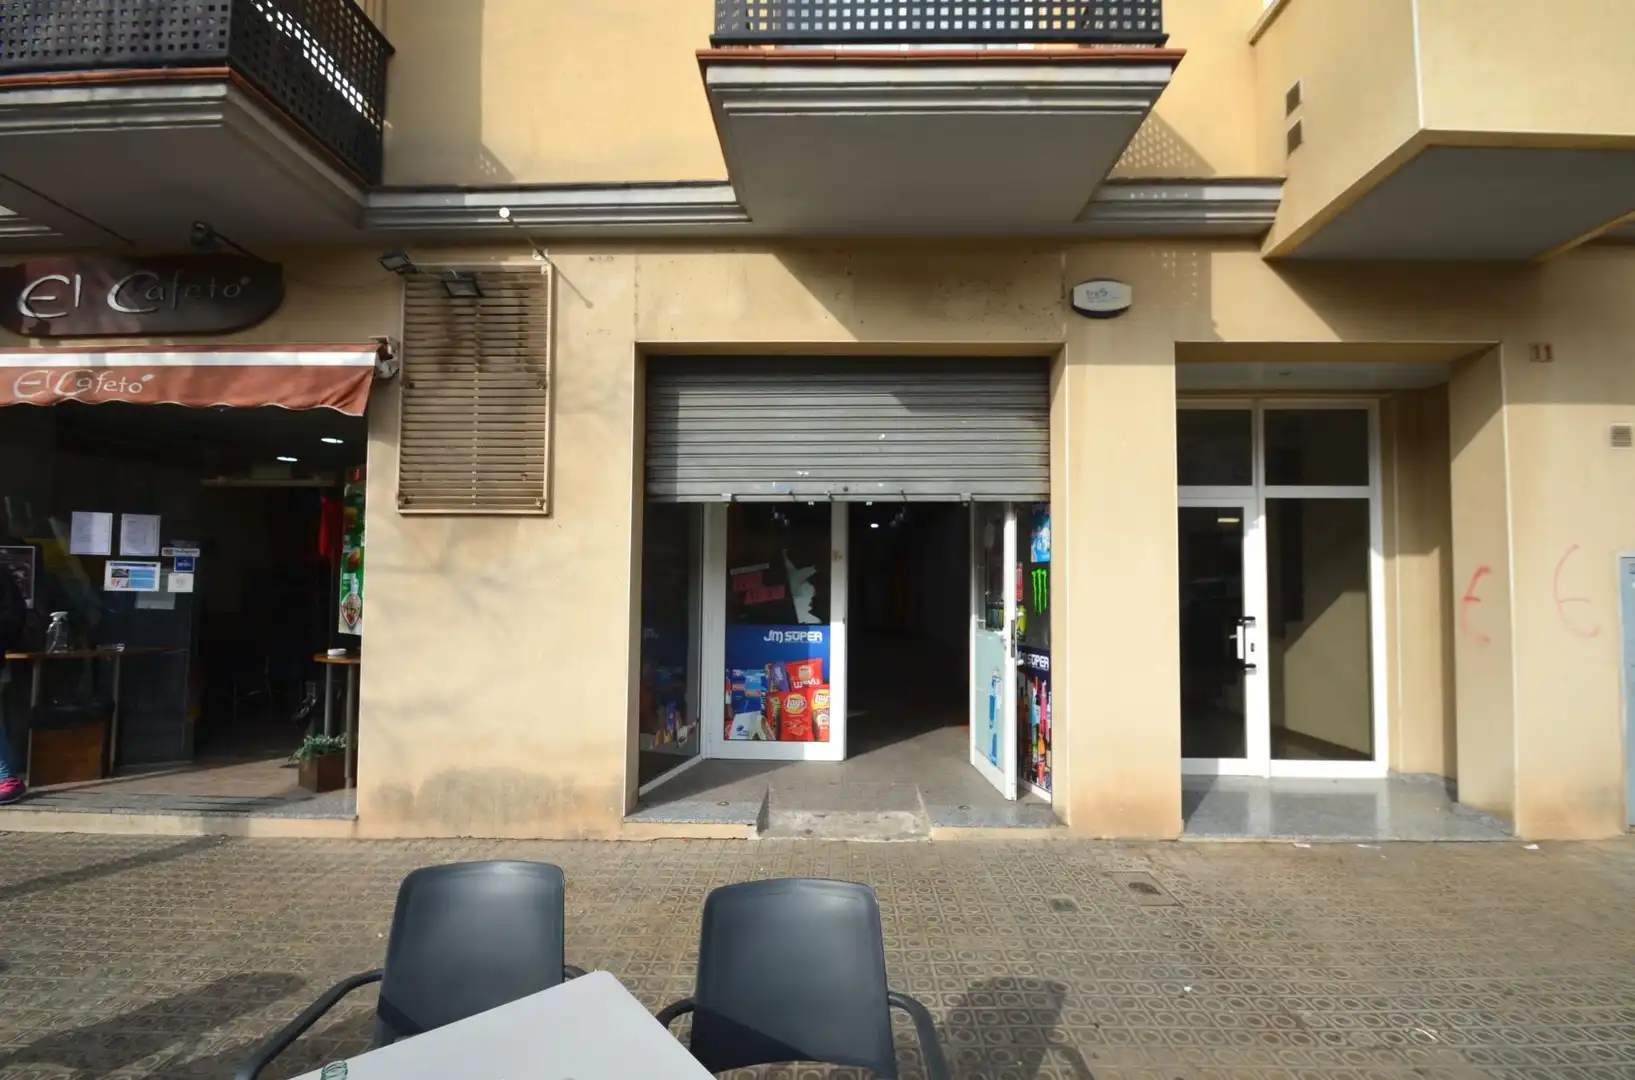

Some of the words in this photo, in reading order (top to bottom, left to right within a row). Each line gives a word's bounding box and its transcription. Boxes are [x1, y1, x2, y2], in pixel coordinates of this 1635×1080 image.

[17, 273, 82, 318] El
[106, 270, 242, 313] Cafeto
[1533, 344, 1552, 360] 11
[13, 369, 52, 399] El
[53, 368, 144, 397] Cafeto
[784, 630, 823, 644] SUPER
